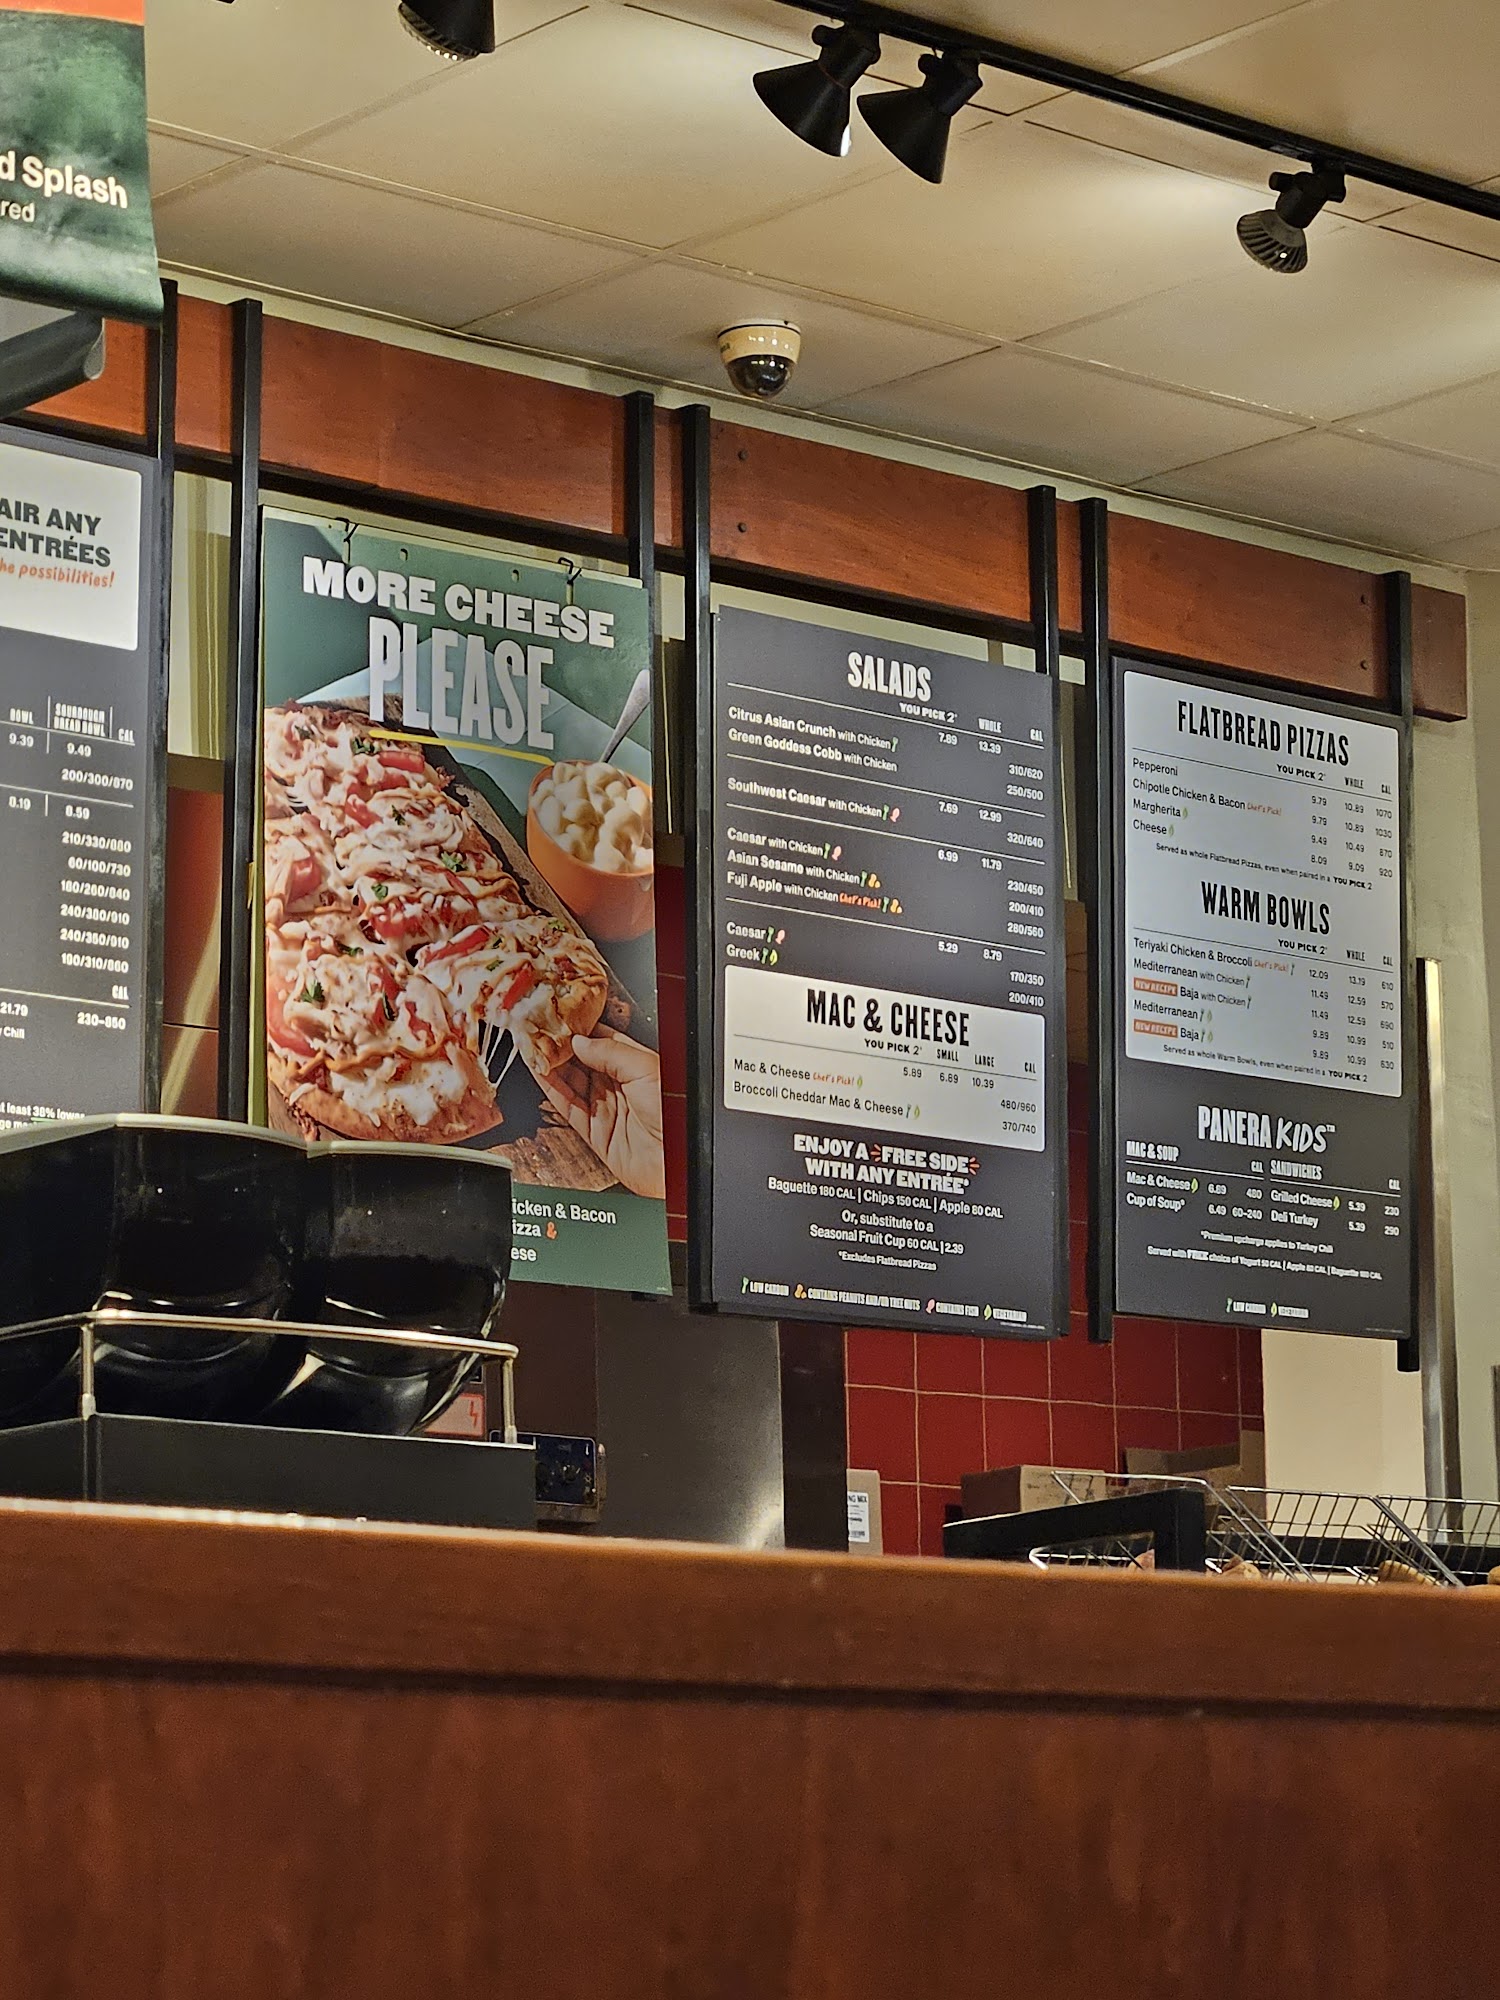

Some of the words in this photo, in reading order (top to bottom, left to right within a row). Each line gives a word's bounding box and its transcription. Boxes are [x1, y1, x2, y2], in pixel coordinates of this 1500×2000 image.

[22, 155, 128, 209] Splash
[46, 508, 102, 536] ANY
[19, 564, 115, 588] possibilities!
[303, 555, 437, 616] MORE
[444, 584, 616, 649] CHEESE
[369, 616, 554, 750] PLEASE
[848, 652, 931, 702] SALADS
[118, 728, 134, 743] CAL
[728, 706, 762, 724] Citrus
[764, 713, 795, 731] Asian
[797, 720, 836, 738] Crunch
[838, 730, 857, 743] with
[857, 734, 891, 749] Chicken
[899, 703, 920, 715] YOU
[922, 707, 944, 720] PICK
[978, 718, 1002, 733] WHOLE
[1030, 729, 1043, 742] CAL
[1178, 700, 1281, 751] FLATBREAD
[1287, 723, 1349, 766] PIZZAS
[728, 728, 762, 745] Green
[764, 735, 811, 755] Goddess
[813, 745, 842, 761] Cobb
[844, 753, 862, 765] with
[864, 756, 897, 772] Chicken
[1132, 757, 1178, 777] Pepperoni
[1276, 763, 1294, 775] YOU
[1296, 768, 1316, 780] PICK
[1345, 776, 1364, 789] WHOLE
[727, 777, 787, 800] Southwest
[788, 788, 826, 807] Caesar
[828, 799, 847, 812] with
[848, 802, 882, 818] Chicken
[1132, 778, 1170, 795] Chipotle
[1172, 785, 1207, 802] Chicken
[1209, 793, 1216, 804] &
[1218, 795, 1246, 810] Bacon
[1132, 798, 1181, 817] Margherita
[727, 827, 767, 845] Caesar
[768, 837, 787, 849] with
[788, 840, 823, 856] Chicken
[1132, 819, 1167, 834] Cheese
[727, 849, 759, 866] Asian
[760, 856, 804, 875] Sesame
[806, 865, 825, 878] with
[826, 869, 860, 884] Chicken
[1156, 842, 1179, 854] Served
[1333, 876, 1347, 886] YOU
[727, 871, 747, 889] Fuji
[750, 875, 782, 893] Apple
[784, 883, 803, 896] with
[804, 886, 838, 902] Chicken
[1200, 881, 1260, 924] WARM
[1267, 893, 1331, 935] BOWLS
[726, 921, 766, 940] Caesar
[726, 944, 760, 961] Greek
[1134, 937, 1168, 953] Teriyaki
[1170, 944, 1206, 959] Chicken
[1207, 950, 1215, 960] &
[1217, 952, 1252, 967] Broccoli
[1278, 939, 1295, 950] YOU
[1297, 943, 1317, 954] PICK
[1134, 958, 1197, 978] Mediterranean
[1200, 971, 1215, 980] with
[1216, 973, 1244, 985] Chicken
[1134, 999, 1198, 1019] Mediterranean
[1180, 986, 1199, 1000] Baja
[1201, 991, 1216, 1001] with
[1217, 994, 1246, 1006] Chicken
[807, 988, 856, 1029] MAC
[863, 998, 883, 1033] &
[890, 1001, 970, 1047] CHEESE
[1163, 1044, 1186, 1055] Served
[1180, 1028, 1199, 1041] Baja
[865, 1038, 884, 1050] YOU
[887, 1042, 910, 1054] PICK
[936, 1048, 959, 1062] SMALL
[974, 1054, 995, 1068] LARGE
[1024, 1062, 1036, 1074] CAL
[734, 1058, 756, 1072] Mac
[759, 1062, 767, 1074] &
[770, 1064, 811, 1080] Cheese
[972, 1077, 995, 1089] 10.39
[7, 1102, 31, 1116] least
[734, 1081, 778, 1098] Broccoli
[781, 1087, 826, 1105] Cheddar
[829, 1094, 850, 1108] Mac
[853, 1098, 862, 1110] &
[864, 1100, 904, 1116] Cheese
[1000, 1099, 1037, 1113] 480/960
[1002, 1121, 1037, 1134] 370/740
[1198, 1105, 1272, 1148] PANERA
[793, 1133, 854, 1158] ENJOY
[855, 1142, 869, 1161] A
[881, 1145, 927, 1168] FREE
[929, 1151, 969, 1174] SIDE
[1147, 1143, 1156, 1159] &
[1156, 1145, 1179, 1162] SOUP
[804, 1157, 855, 1181] WITH
[856, 1164, 895, 1186] ANY
[768, 1176, 818, 1195] Baguette
[818, 1185, 836, 1198] 180
[836, 1187, 856, 1200] CAL
[863, 1189, 895, 1207] Chips
[896, 1195, 912, 1207] 150
[912, 1197, 932, 1210] CAL
[939, 1200, 971, 1216] Apple
[971, 1204, 984, 1216] 80
[984, 1206, 1004, 1218] CAL
[1126, 1171, 1146, 1185] Mac
[1147, 1174, 1155, 1186] &
[1156, 1175, 1190, 1190] Cheese
[1271, 1190, 1299, 1204] Grilled
[1300, 1193, 1332, 1207] Cheese
[555, 1203, 567, 1219] &
[570, 1205, 616, 1224] Bacon
[841, 1209, 858, 1226] Or,
[860, 1214, 912, 1230] substitute
[914, 1219, 925, 1231] to
[926, 1222, 934, 1233] a
[1126, 1193, 1145, 1207] Cup
[1147, 1195, 1157, 1206] of
[1271, 1210, 1288, 1222] Deli
[1289, 1213, 1318, 1228] Turkey
[810, 1224, 857, 1242] Seasonal
[858, 1230, 883, 1245] Fruit
[884, 1235, 906, 1249] Cup
[907, 1238, 919, 1249] 60
[919, 1238, 939, 1251] CAL
[944, 1242, 964, 1255] 2.39
